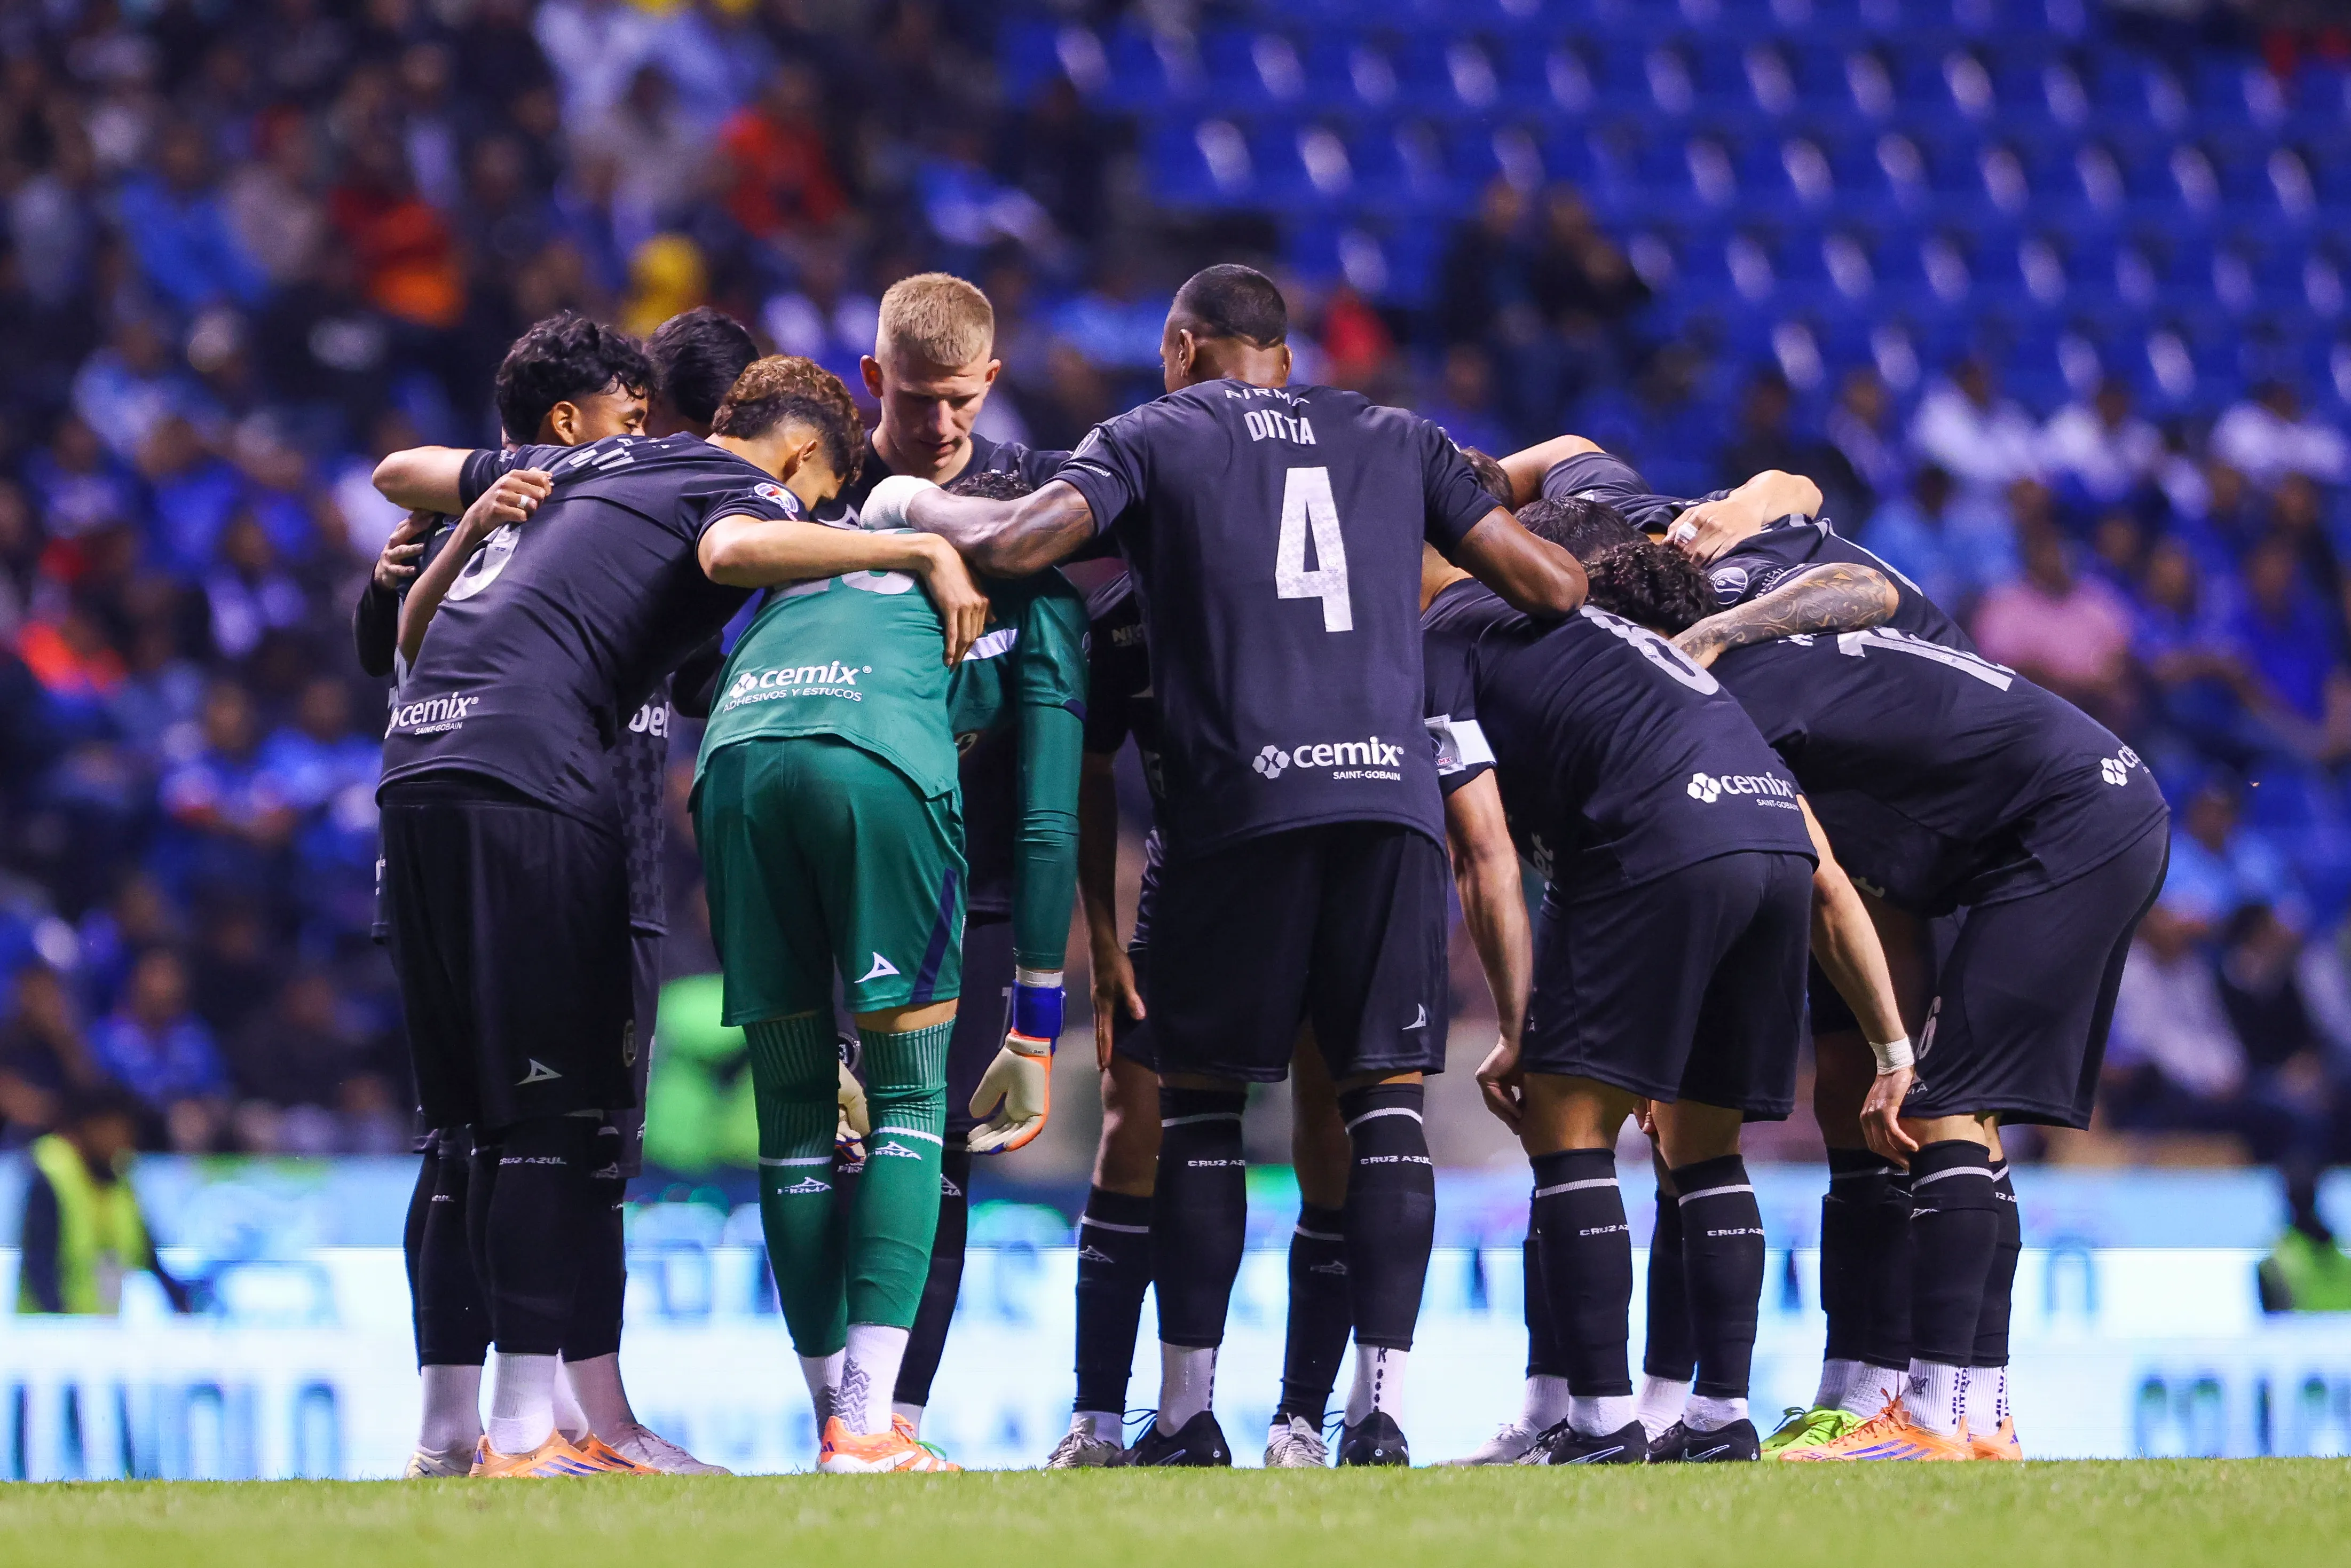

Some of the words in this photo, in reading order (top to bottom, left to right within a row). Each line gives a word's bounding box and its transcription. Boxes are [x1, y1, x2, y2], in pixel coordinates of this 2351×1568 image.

[1243, 409, 1317, 445] DITTA
[1275, 466, 1354, 632] 4
[722, 689, 788, 714] ADHESIVOS
[791, 688, 801, 696] Y
[802, 687, 863, 703] ESTUCOS
[414, 722, 463, 735] SAINT-GOBAIN
[1333, 770, 1401, 781] SAINT-GOBAIN
[1360, 1155, 1399, 1165] CRUZ
[1401, 1155, 1433, 1165] AZUL
[1579, 1225, 1617, 1236] CRUZ
[1707, 1228, 1746, 1236] CRUZ
